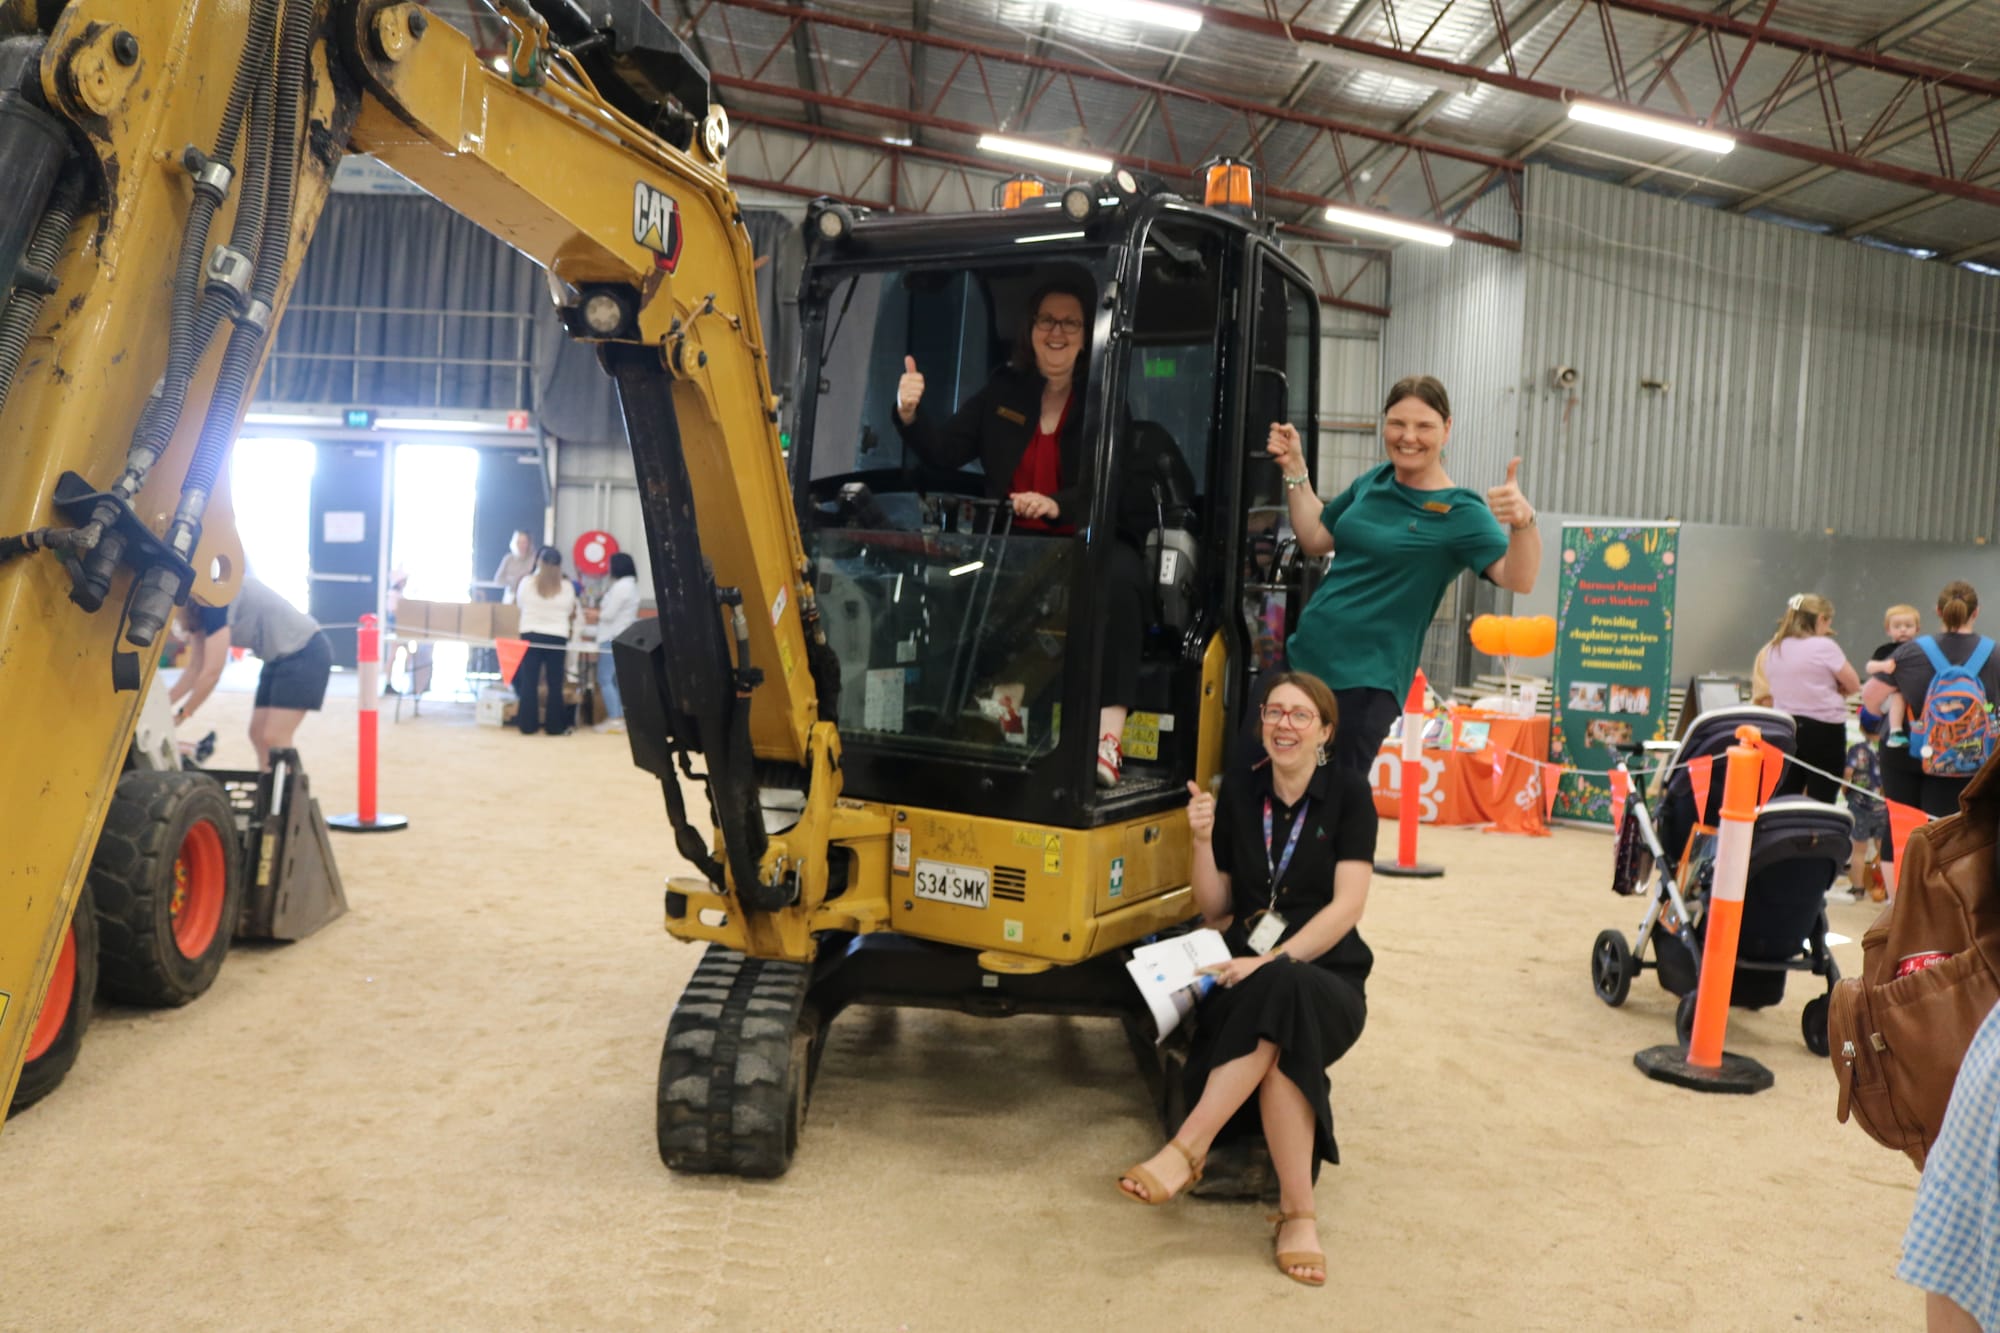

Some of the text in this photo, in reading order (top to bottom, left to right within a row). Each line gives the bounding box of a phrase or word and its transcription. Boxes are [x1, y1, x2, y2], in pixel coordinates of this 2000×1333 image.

[634, 182, 674, 254] CAT
[1617, 581, 1657, 592] Pastoral
[1584, 595, 1650, 606] Care Workers
[1591, 615, 1638, 629] Providing
[1570, 629, 1659, 643] chaplaincy services
[1581, 643, 1644, 656] in your school
[1582, 659, 1642, 671] communities
